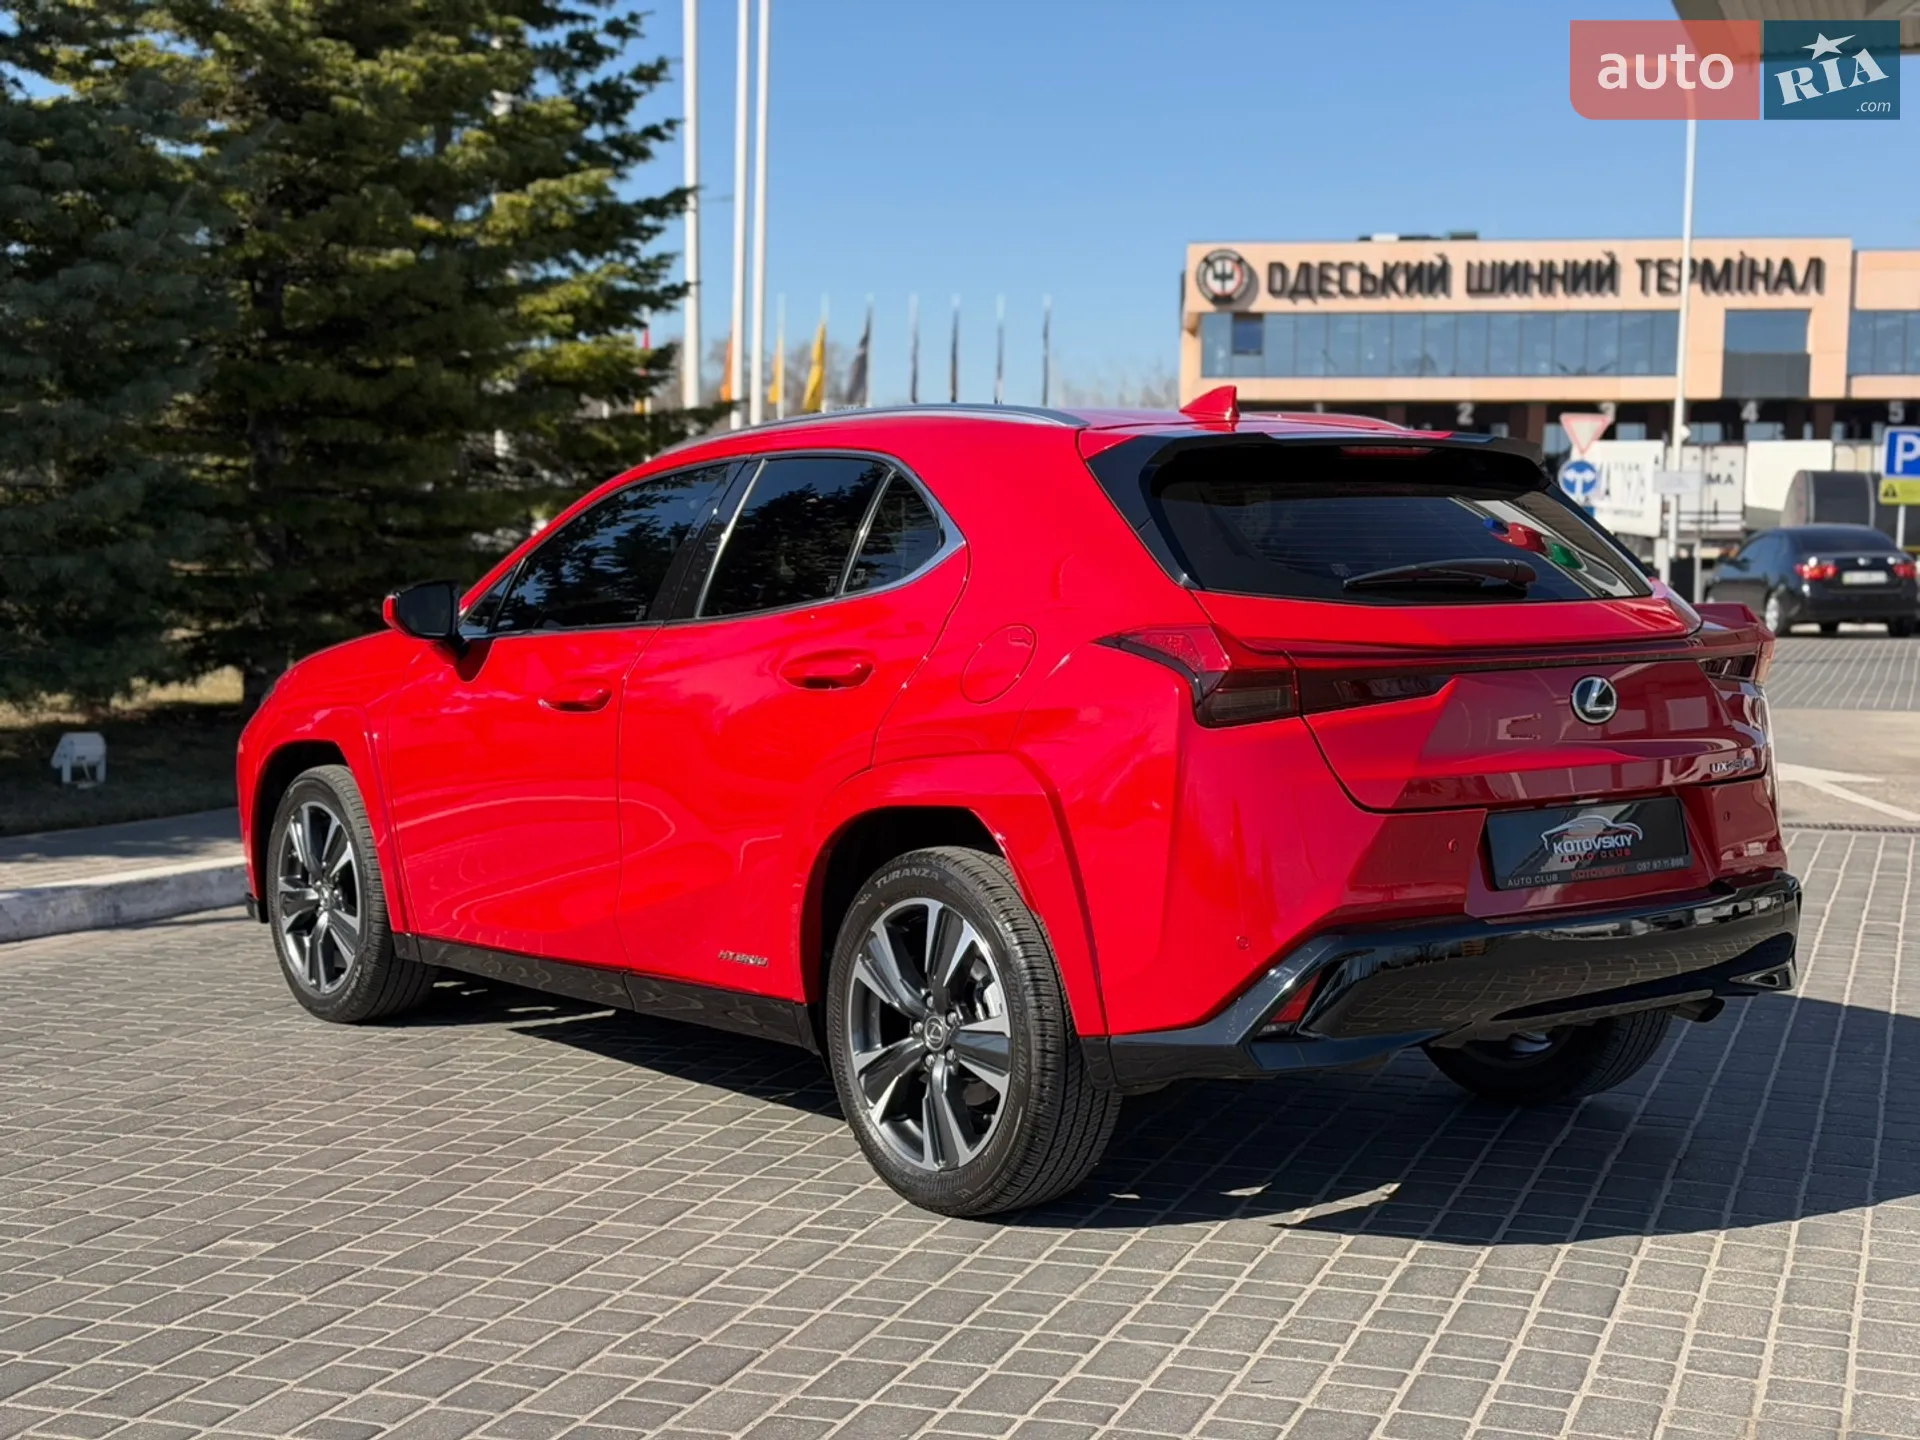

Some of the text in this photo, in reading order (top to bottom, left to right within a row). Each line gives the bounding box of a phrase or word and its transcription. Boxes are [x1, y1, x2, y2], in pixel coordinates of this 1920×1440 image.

[1267, 249, 1825, 304] ОДЕСЬКИЙ ШИННИЙ ТЕРМІНАЛ
[1457, 402, 1473, 425] 2
[1740, 402, 1759, 423] 4
[1889, 402, 1905, 424] 5
[1894, 434, 1920, 473] P
[1553, 834, 1633, 854] KOTOVSKIY
[875, 867, 939, 889] TURANZA
[1508, 874, 1532, 886] AUTO
[1534, 872, 1559, 884] CLUB
